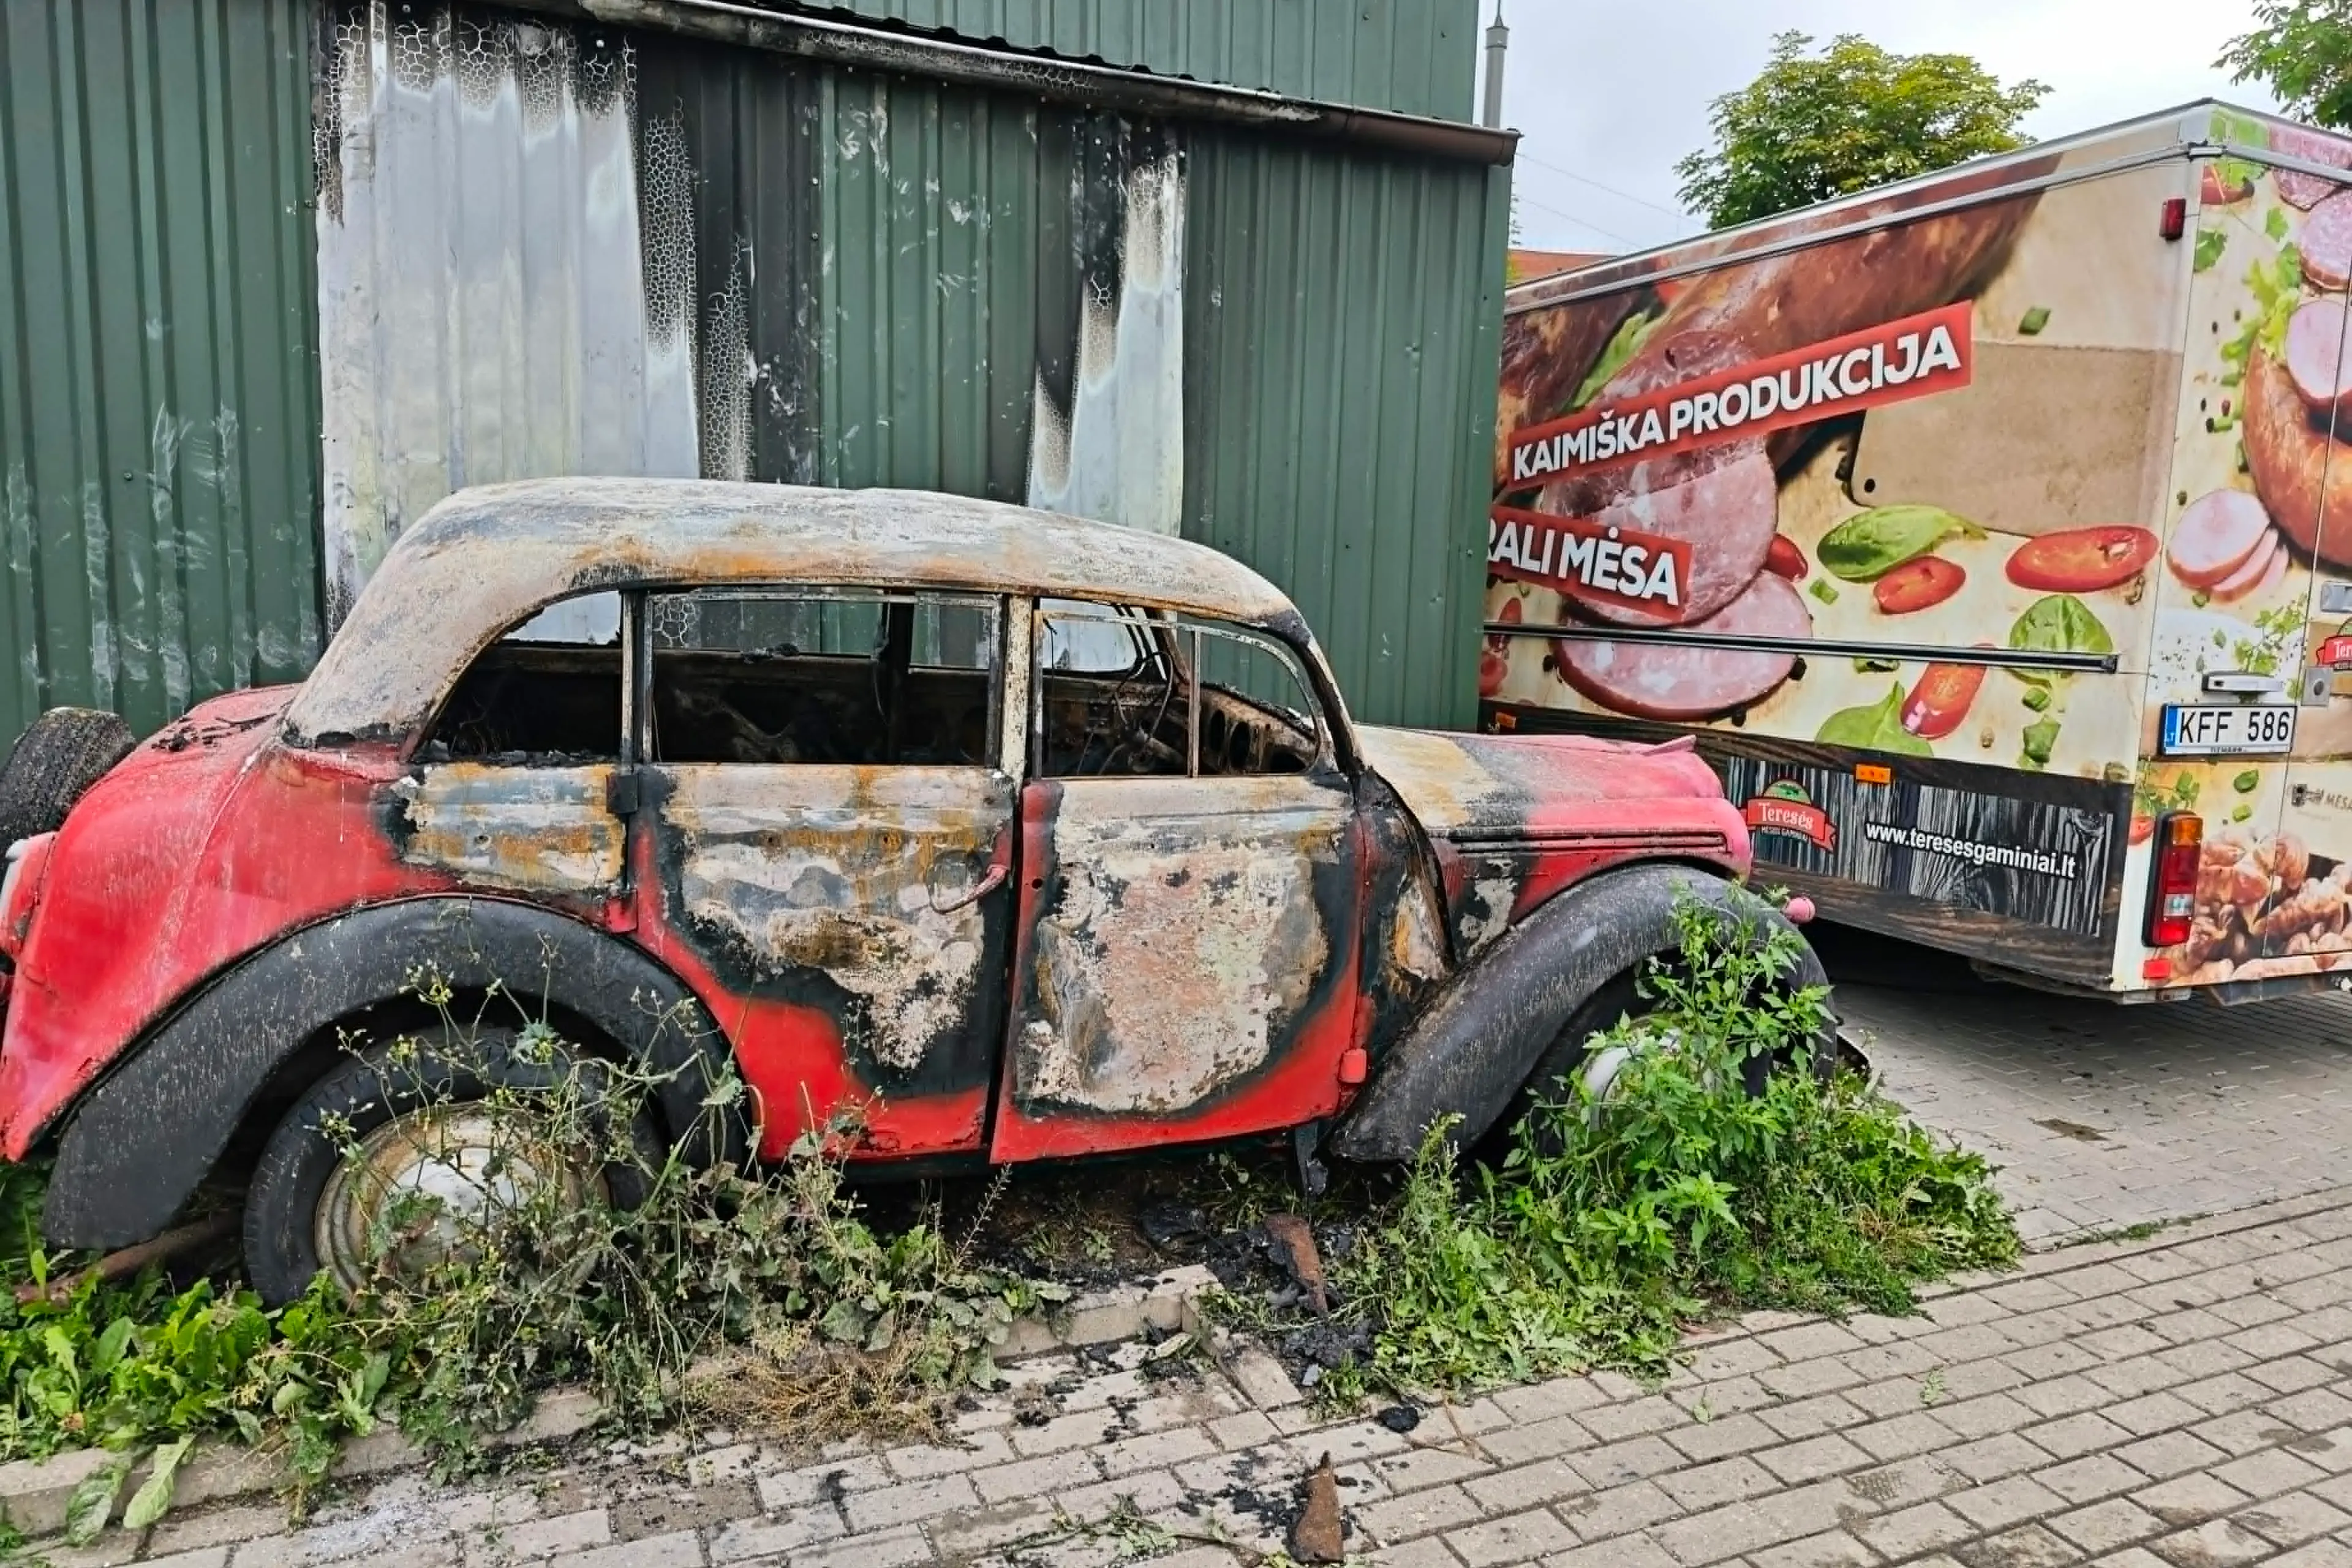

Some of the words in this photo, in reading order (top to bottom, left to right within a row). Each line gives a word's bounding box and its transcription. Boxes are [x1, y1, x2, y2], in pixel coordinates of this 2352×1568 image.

[1514, 408, 1665, 481] KAIMIŠKA
[1669, 325, 1961, 440] PRODUKCIJA
[1558, 526, 1678, 606] MĖSA
[2179, 711, 2233, 743] KFF
[2248, 711, 2290, 742] 586
[1758, 802, 1814, 830] Teresės
[1866, 823, 2076, 878] www.teresesgaminiai.lt
